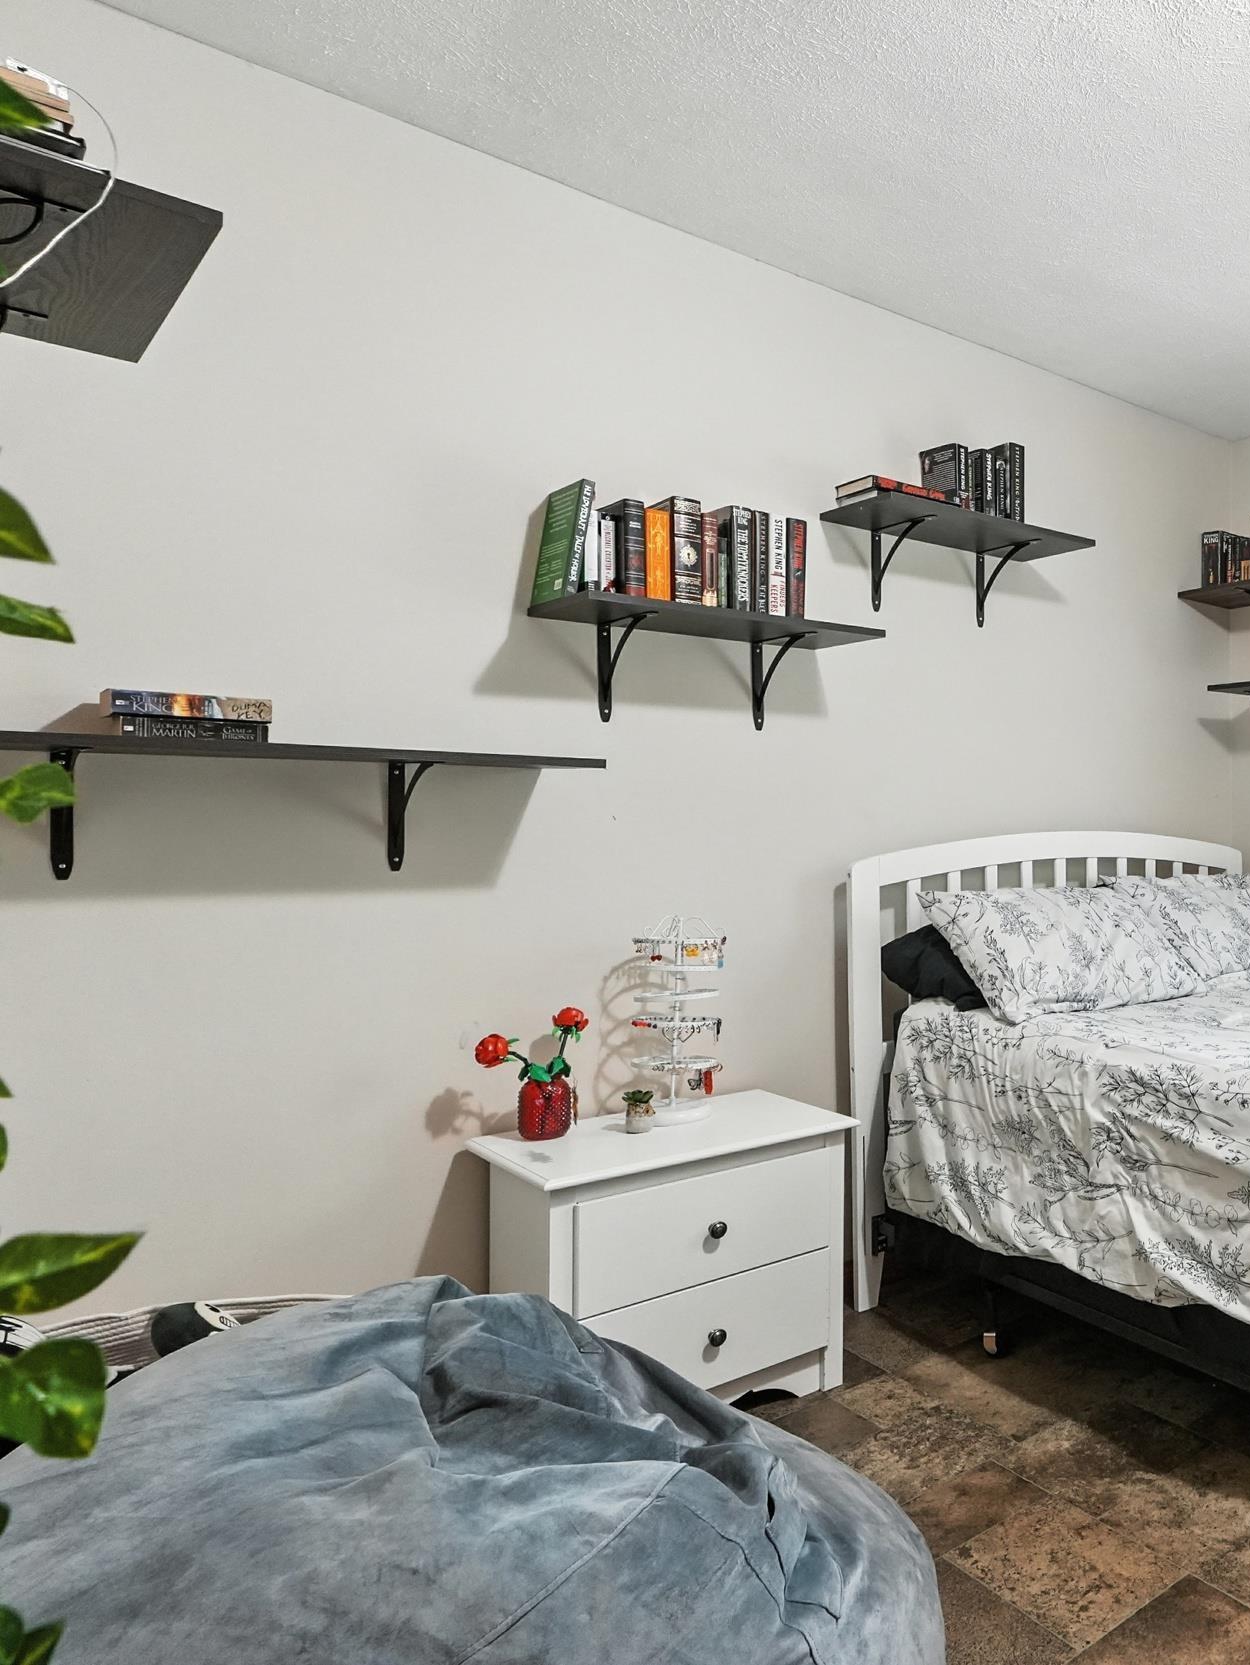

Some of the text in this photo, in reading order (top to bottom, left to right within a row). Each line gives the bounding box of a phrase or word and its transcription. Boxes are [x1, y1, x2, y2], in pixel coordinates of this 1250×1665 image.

[774, 519, 783, 570] STEPHEN KING
[1203, 536, 1218, 544] KING
[793, 523, 803, 569] STEPHEN KING
[770, 584, 778, 613] KEEPERS
[232, 702, 269, 712] DUMA
[237, 709, 265, 720] KEY
[152, 729, 196, 738] MARTIN
